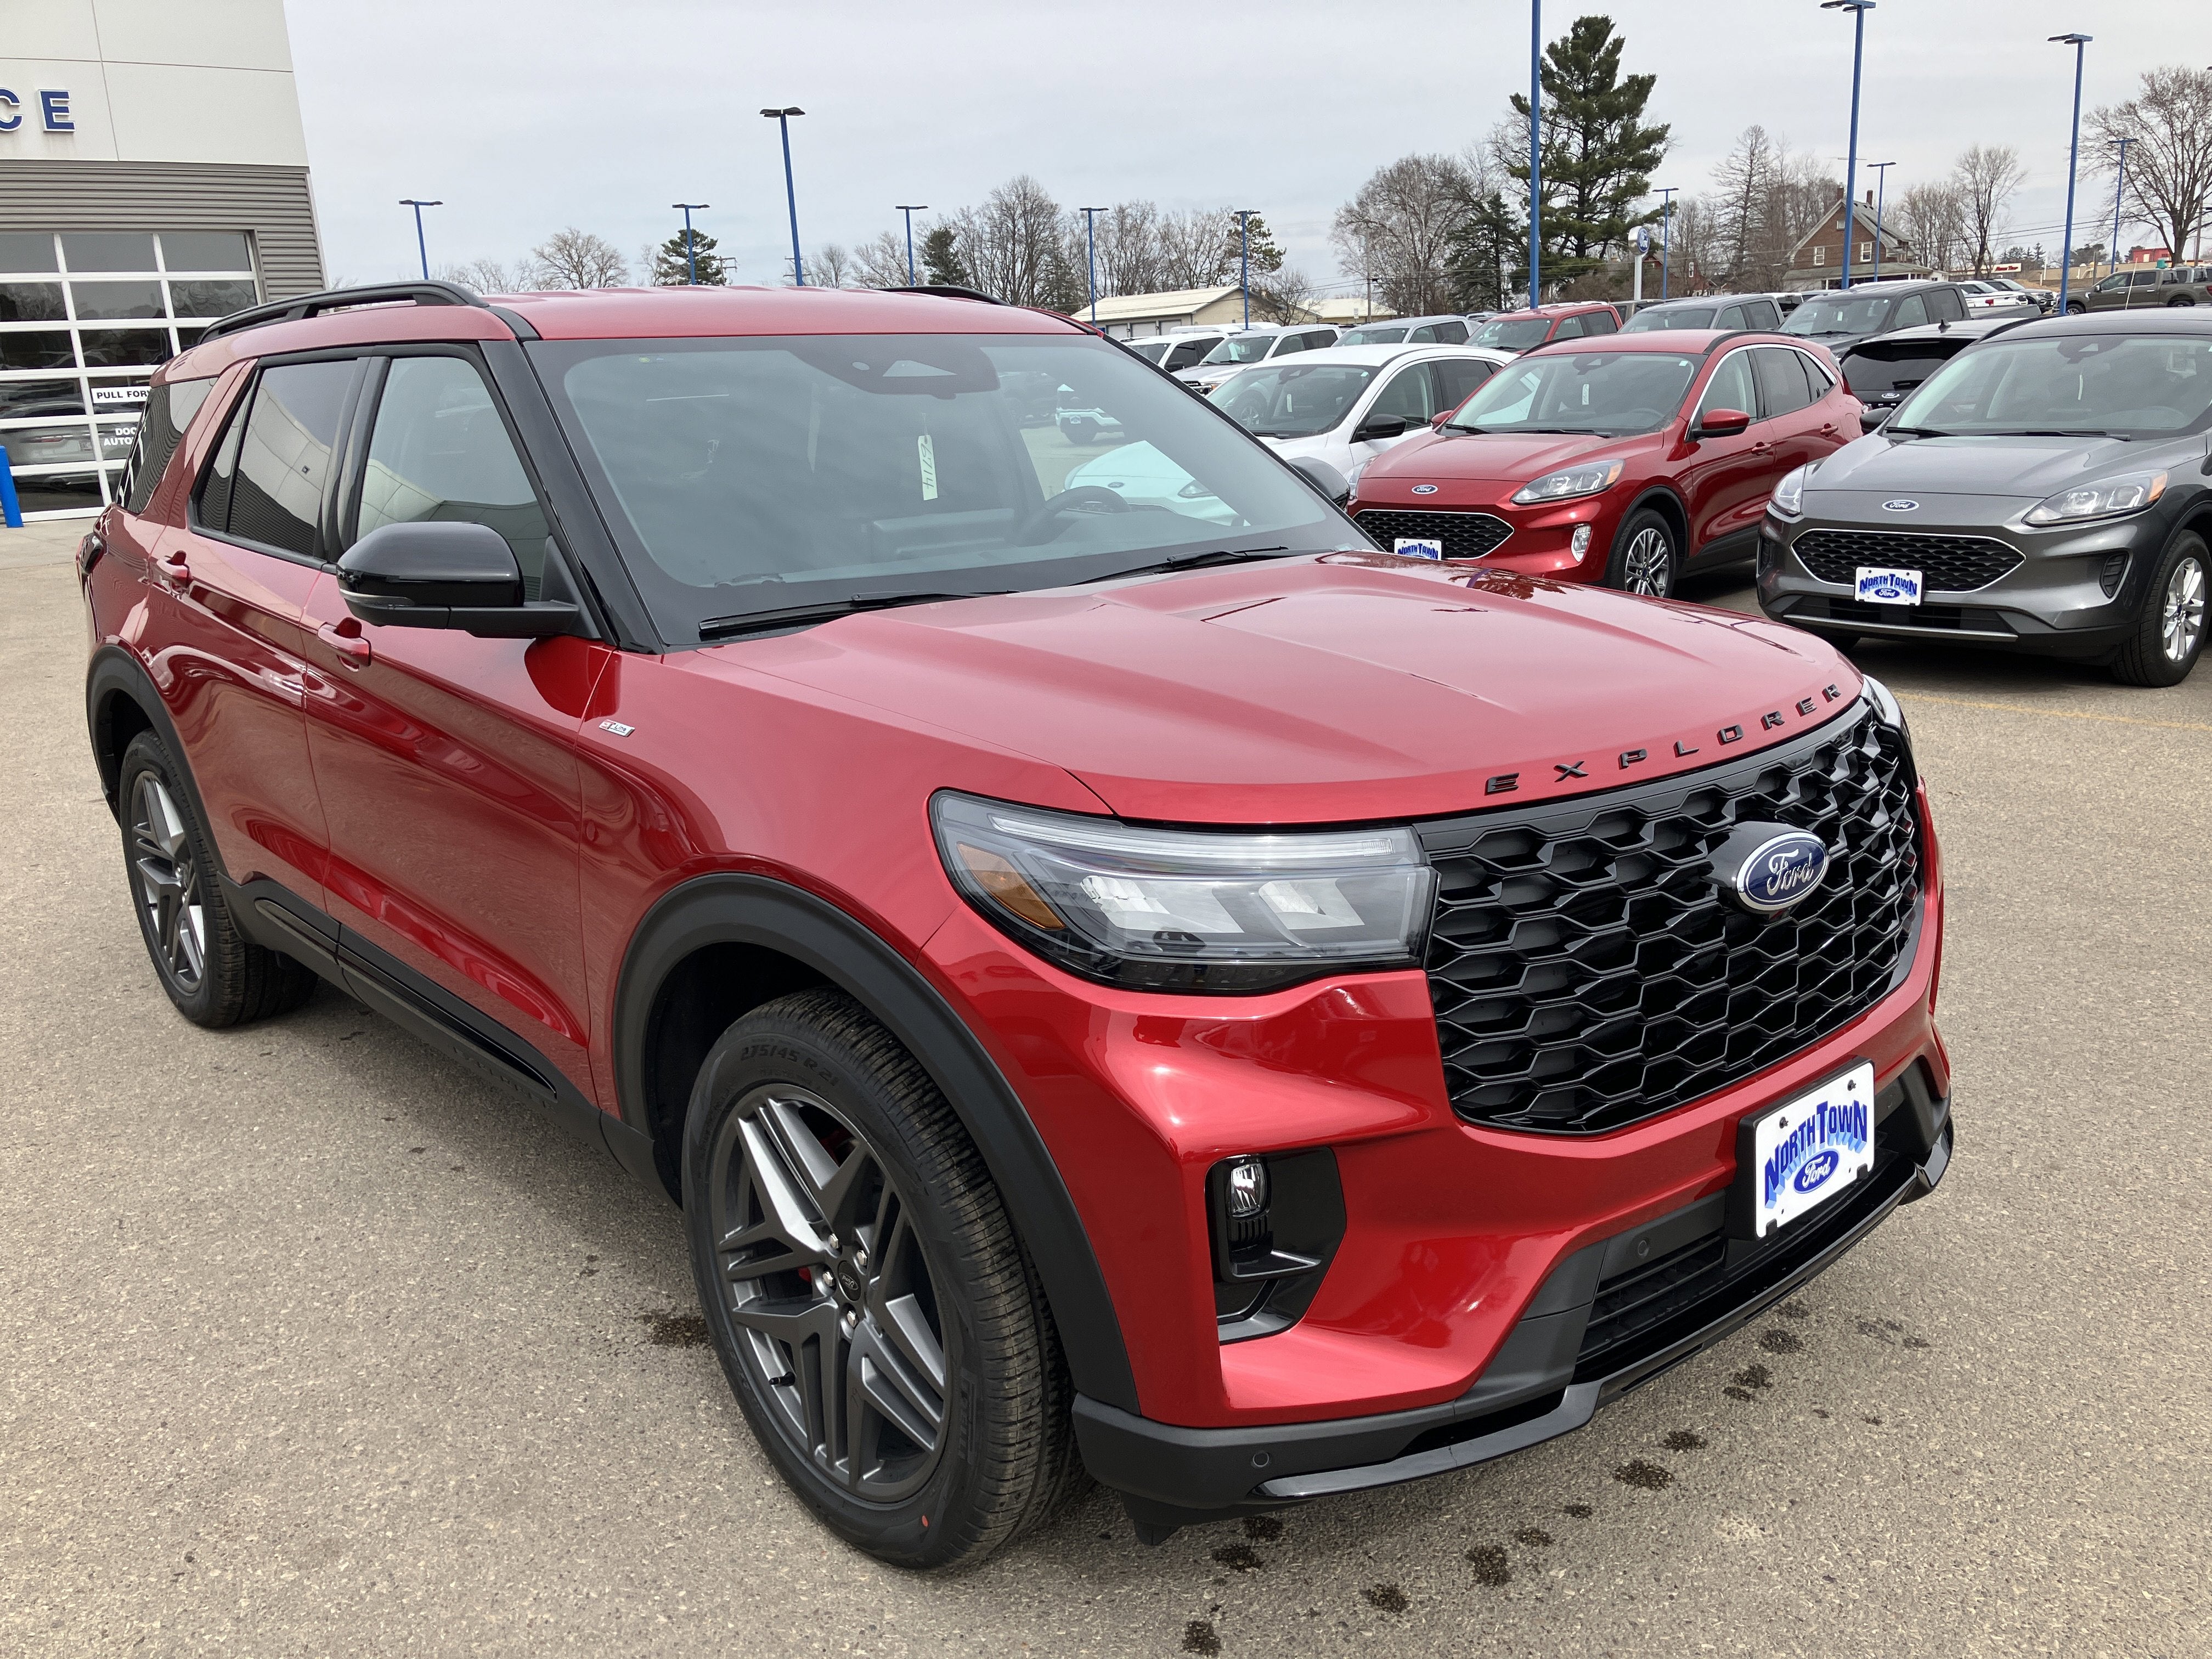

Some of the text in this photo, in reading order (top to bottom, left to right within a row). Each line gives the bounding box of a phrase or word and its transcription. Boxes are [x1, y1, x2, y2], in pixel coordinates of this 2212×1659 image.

[104, 437, 134, 446] AUTO
[921, 443, 934, 489] 6714
[1878, 589, 1895, 597] Ford
[1484, 683, 1842, 796] EXPLORER
[1767, 848, 1814, 896] Ford
[1802, 1155, 1831, 1188] Ford
